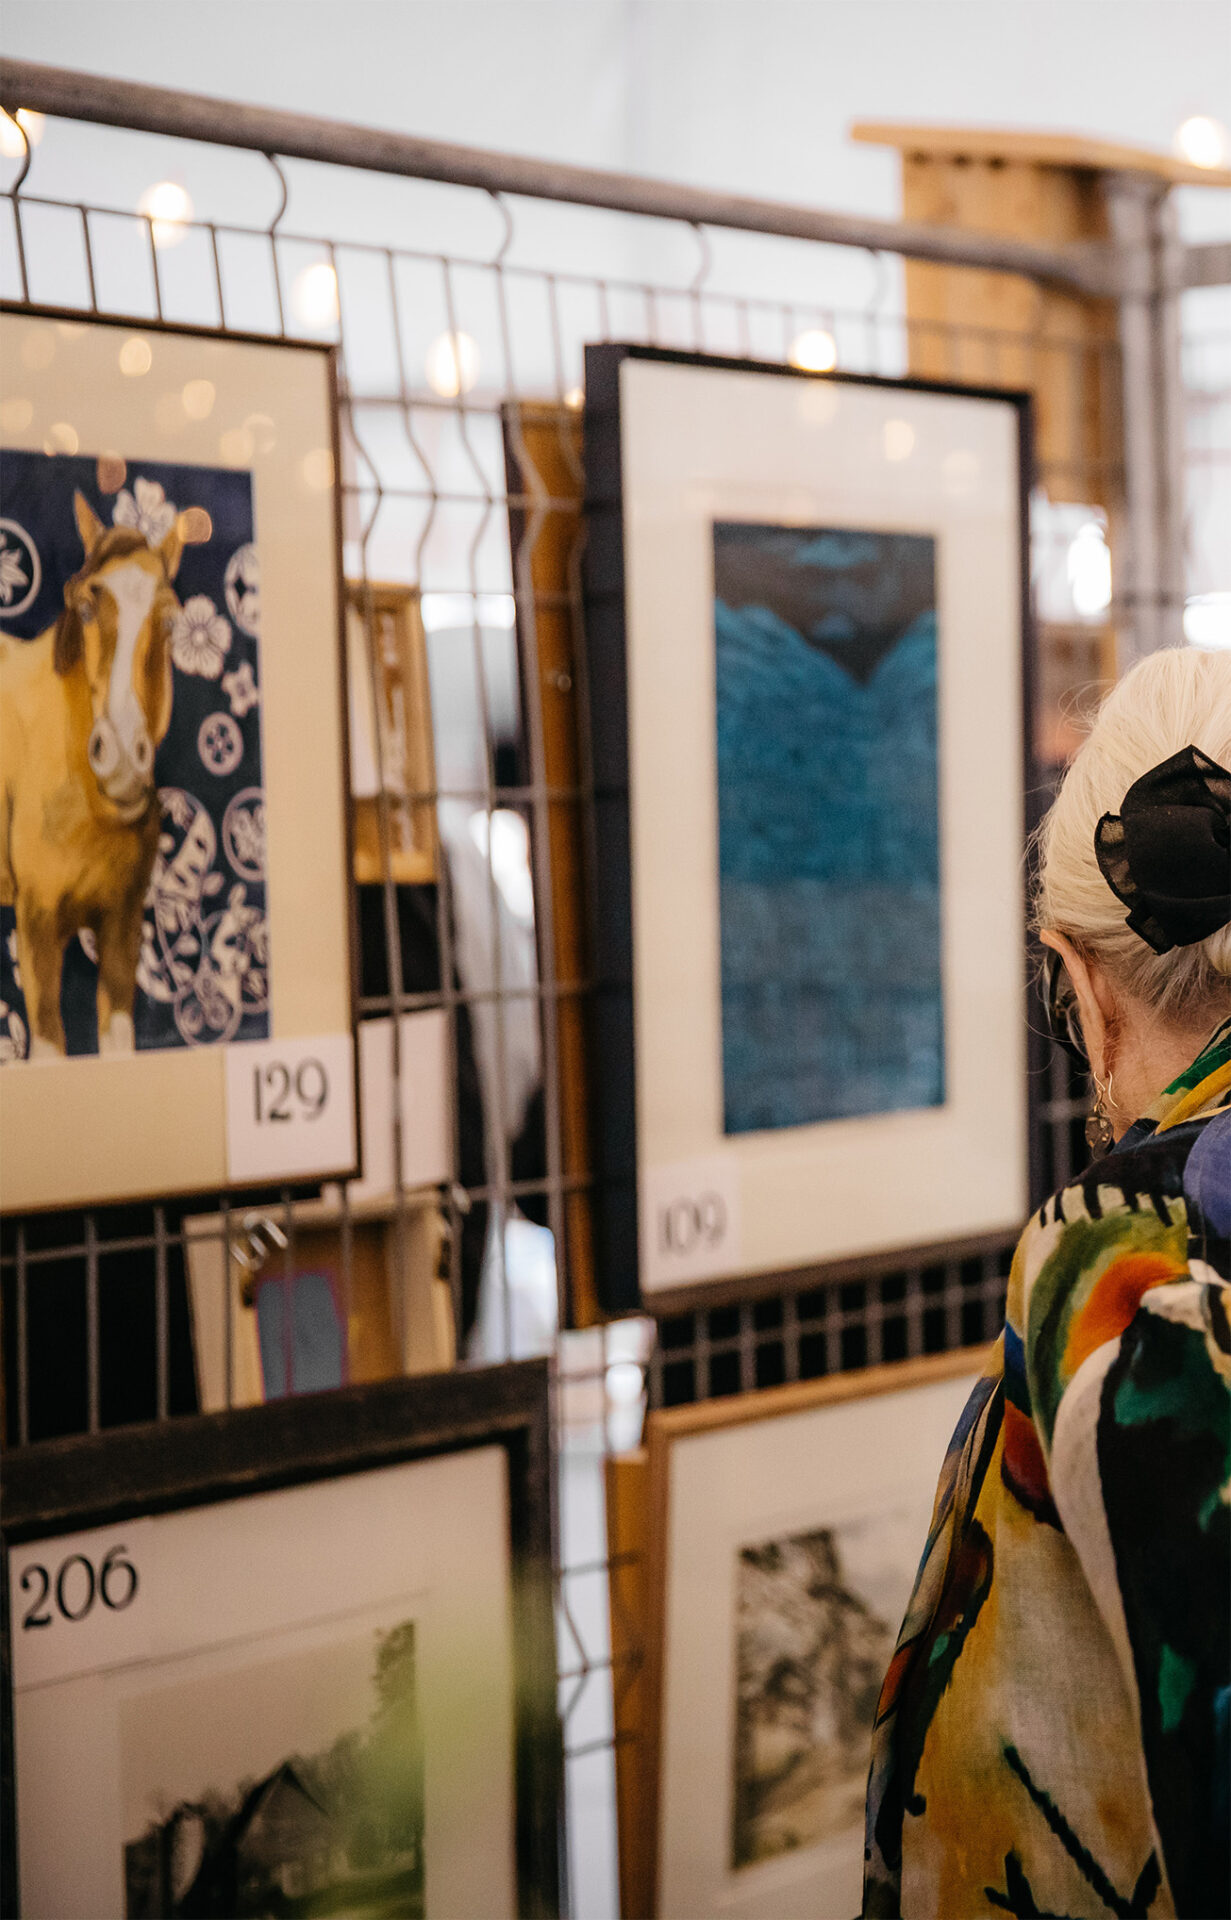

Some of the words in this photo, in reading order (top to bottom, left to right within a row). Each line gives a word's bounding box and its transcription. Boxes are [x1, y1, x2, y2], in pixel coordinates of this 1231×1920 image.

[253, 1058, 329, 1125] 129
[659, 1192, 727, 1256] 109
[20, 1544, 138, 1631] 206
